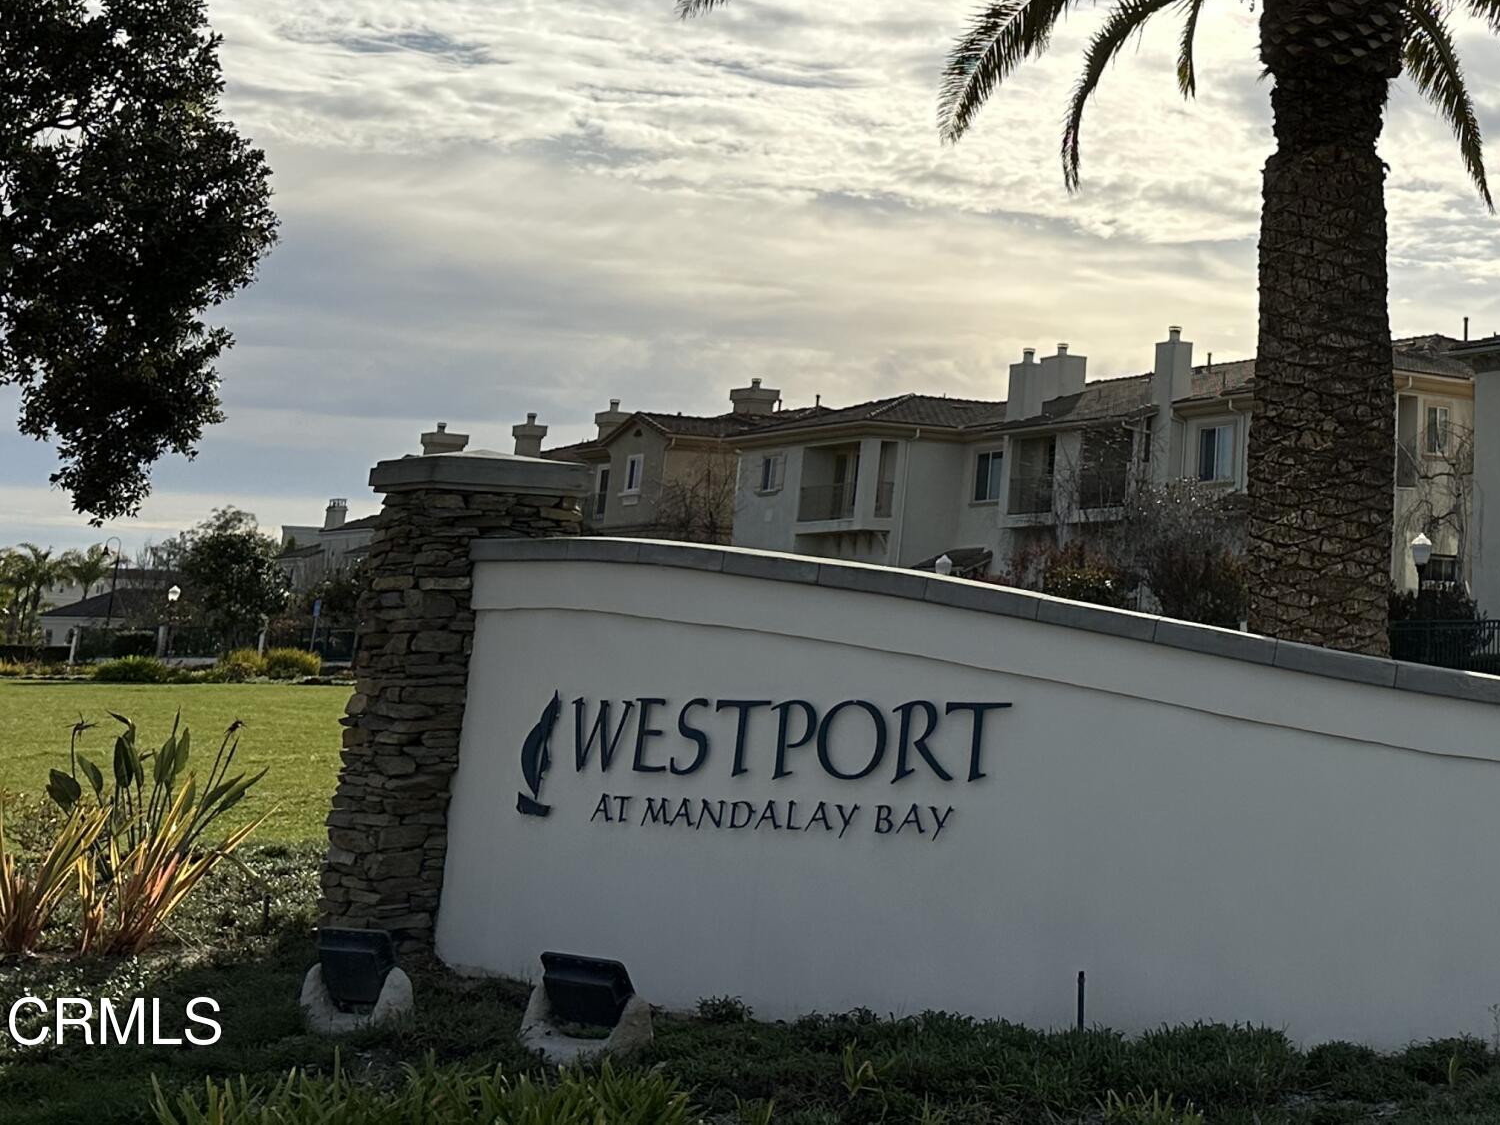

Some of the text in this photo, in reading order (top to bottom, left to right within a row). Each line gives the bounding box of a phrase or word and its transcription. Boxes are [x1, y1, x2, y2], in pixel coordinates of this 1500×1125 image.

[571, 696, 1013, 785] WESTPORT
[590, 793, 955, 842] AT MANDALAY BAY
